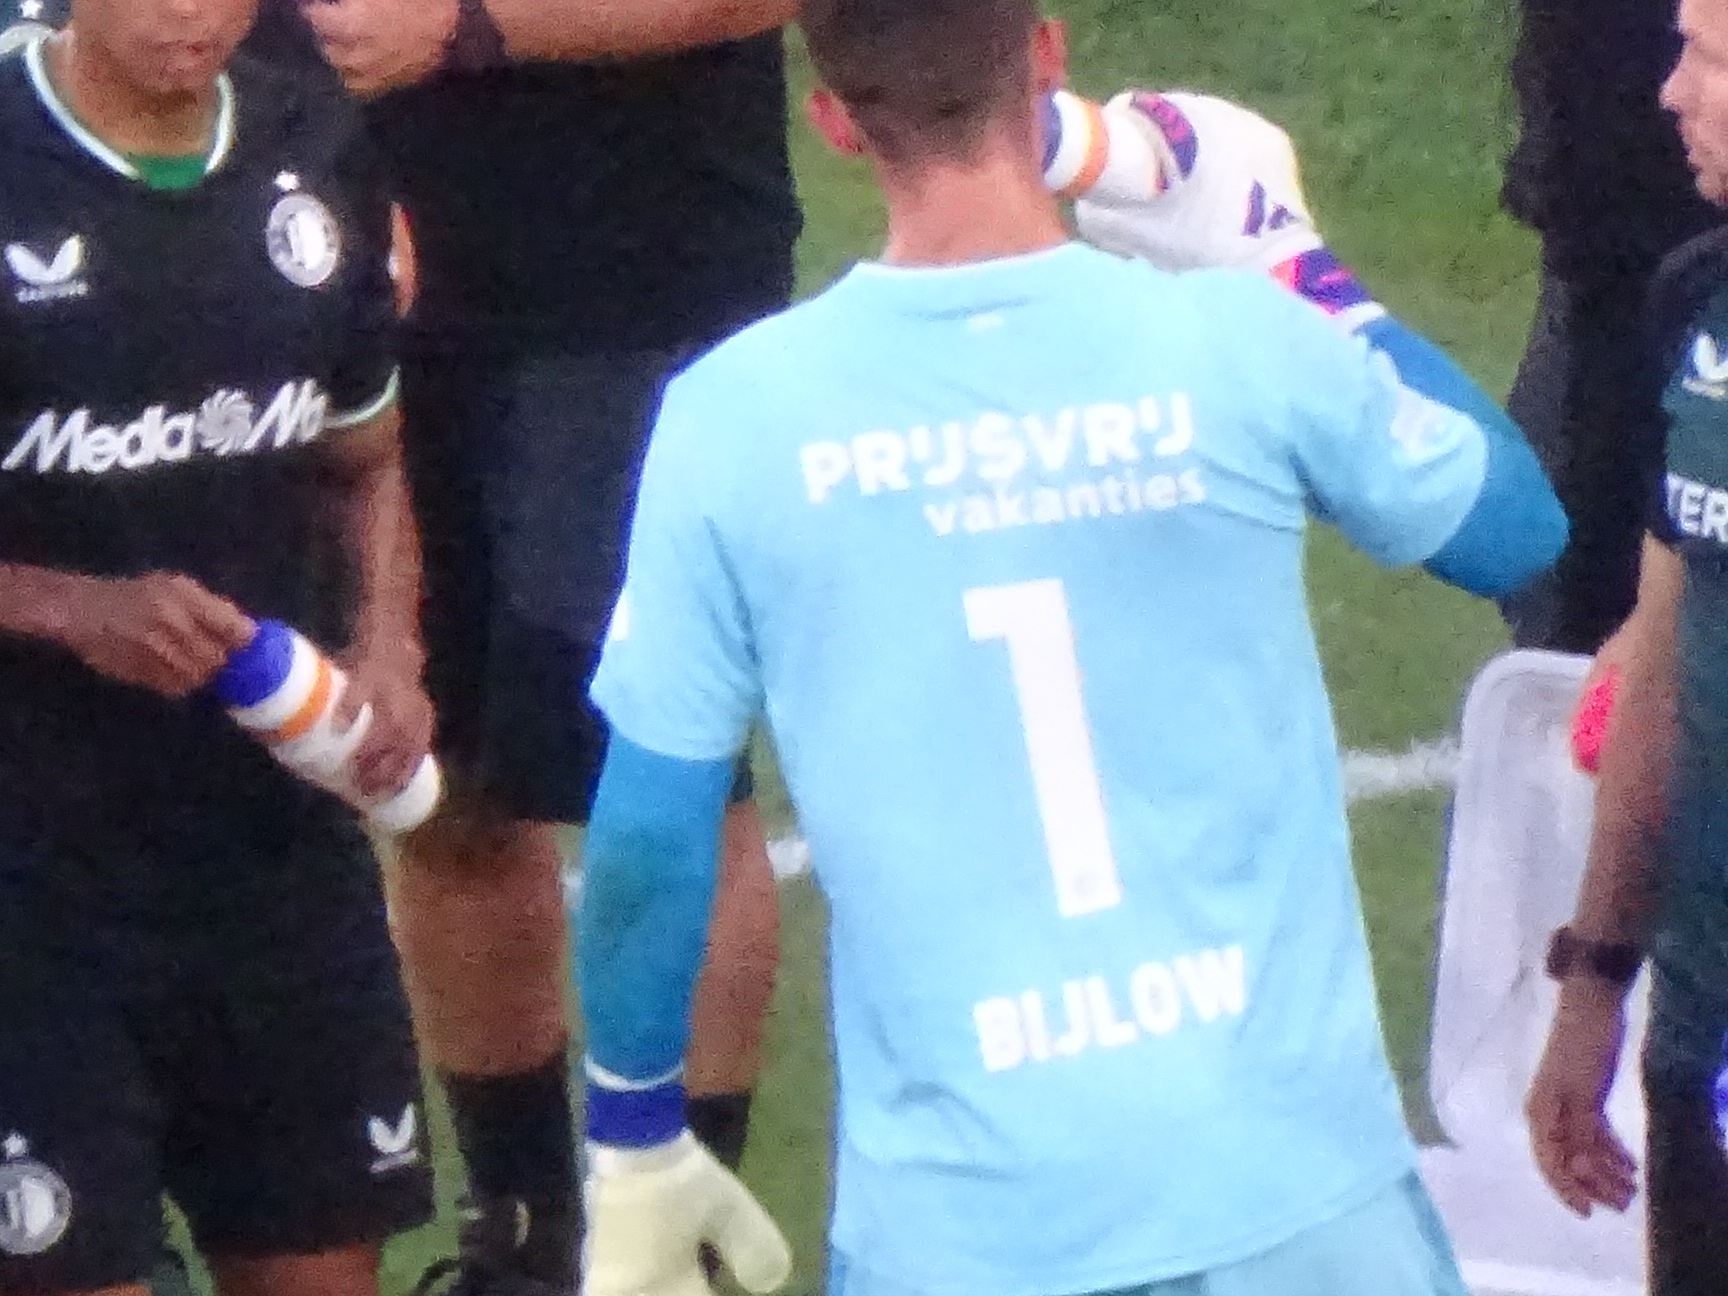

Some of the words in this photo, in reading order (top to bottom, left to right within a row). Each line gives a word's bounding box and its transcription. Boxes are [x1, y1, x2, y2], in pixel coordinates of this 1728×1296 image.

[923, 467, 1206, 537] vakanties
[962, 578, 1122, 918] 1
[972, 943, 1248, 1074] BIJLOW
